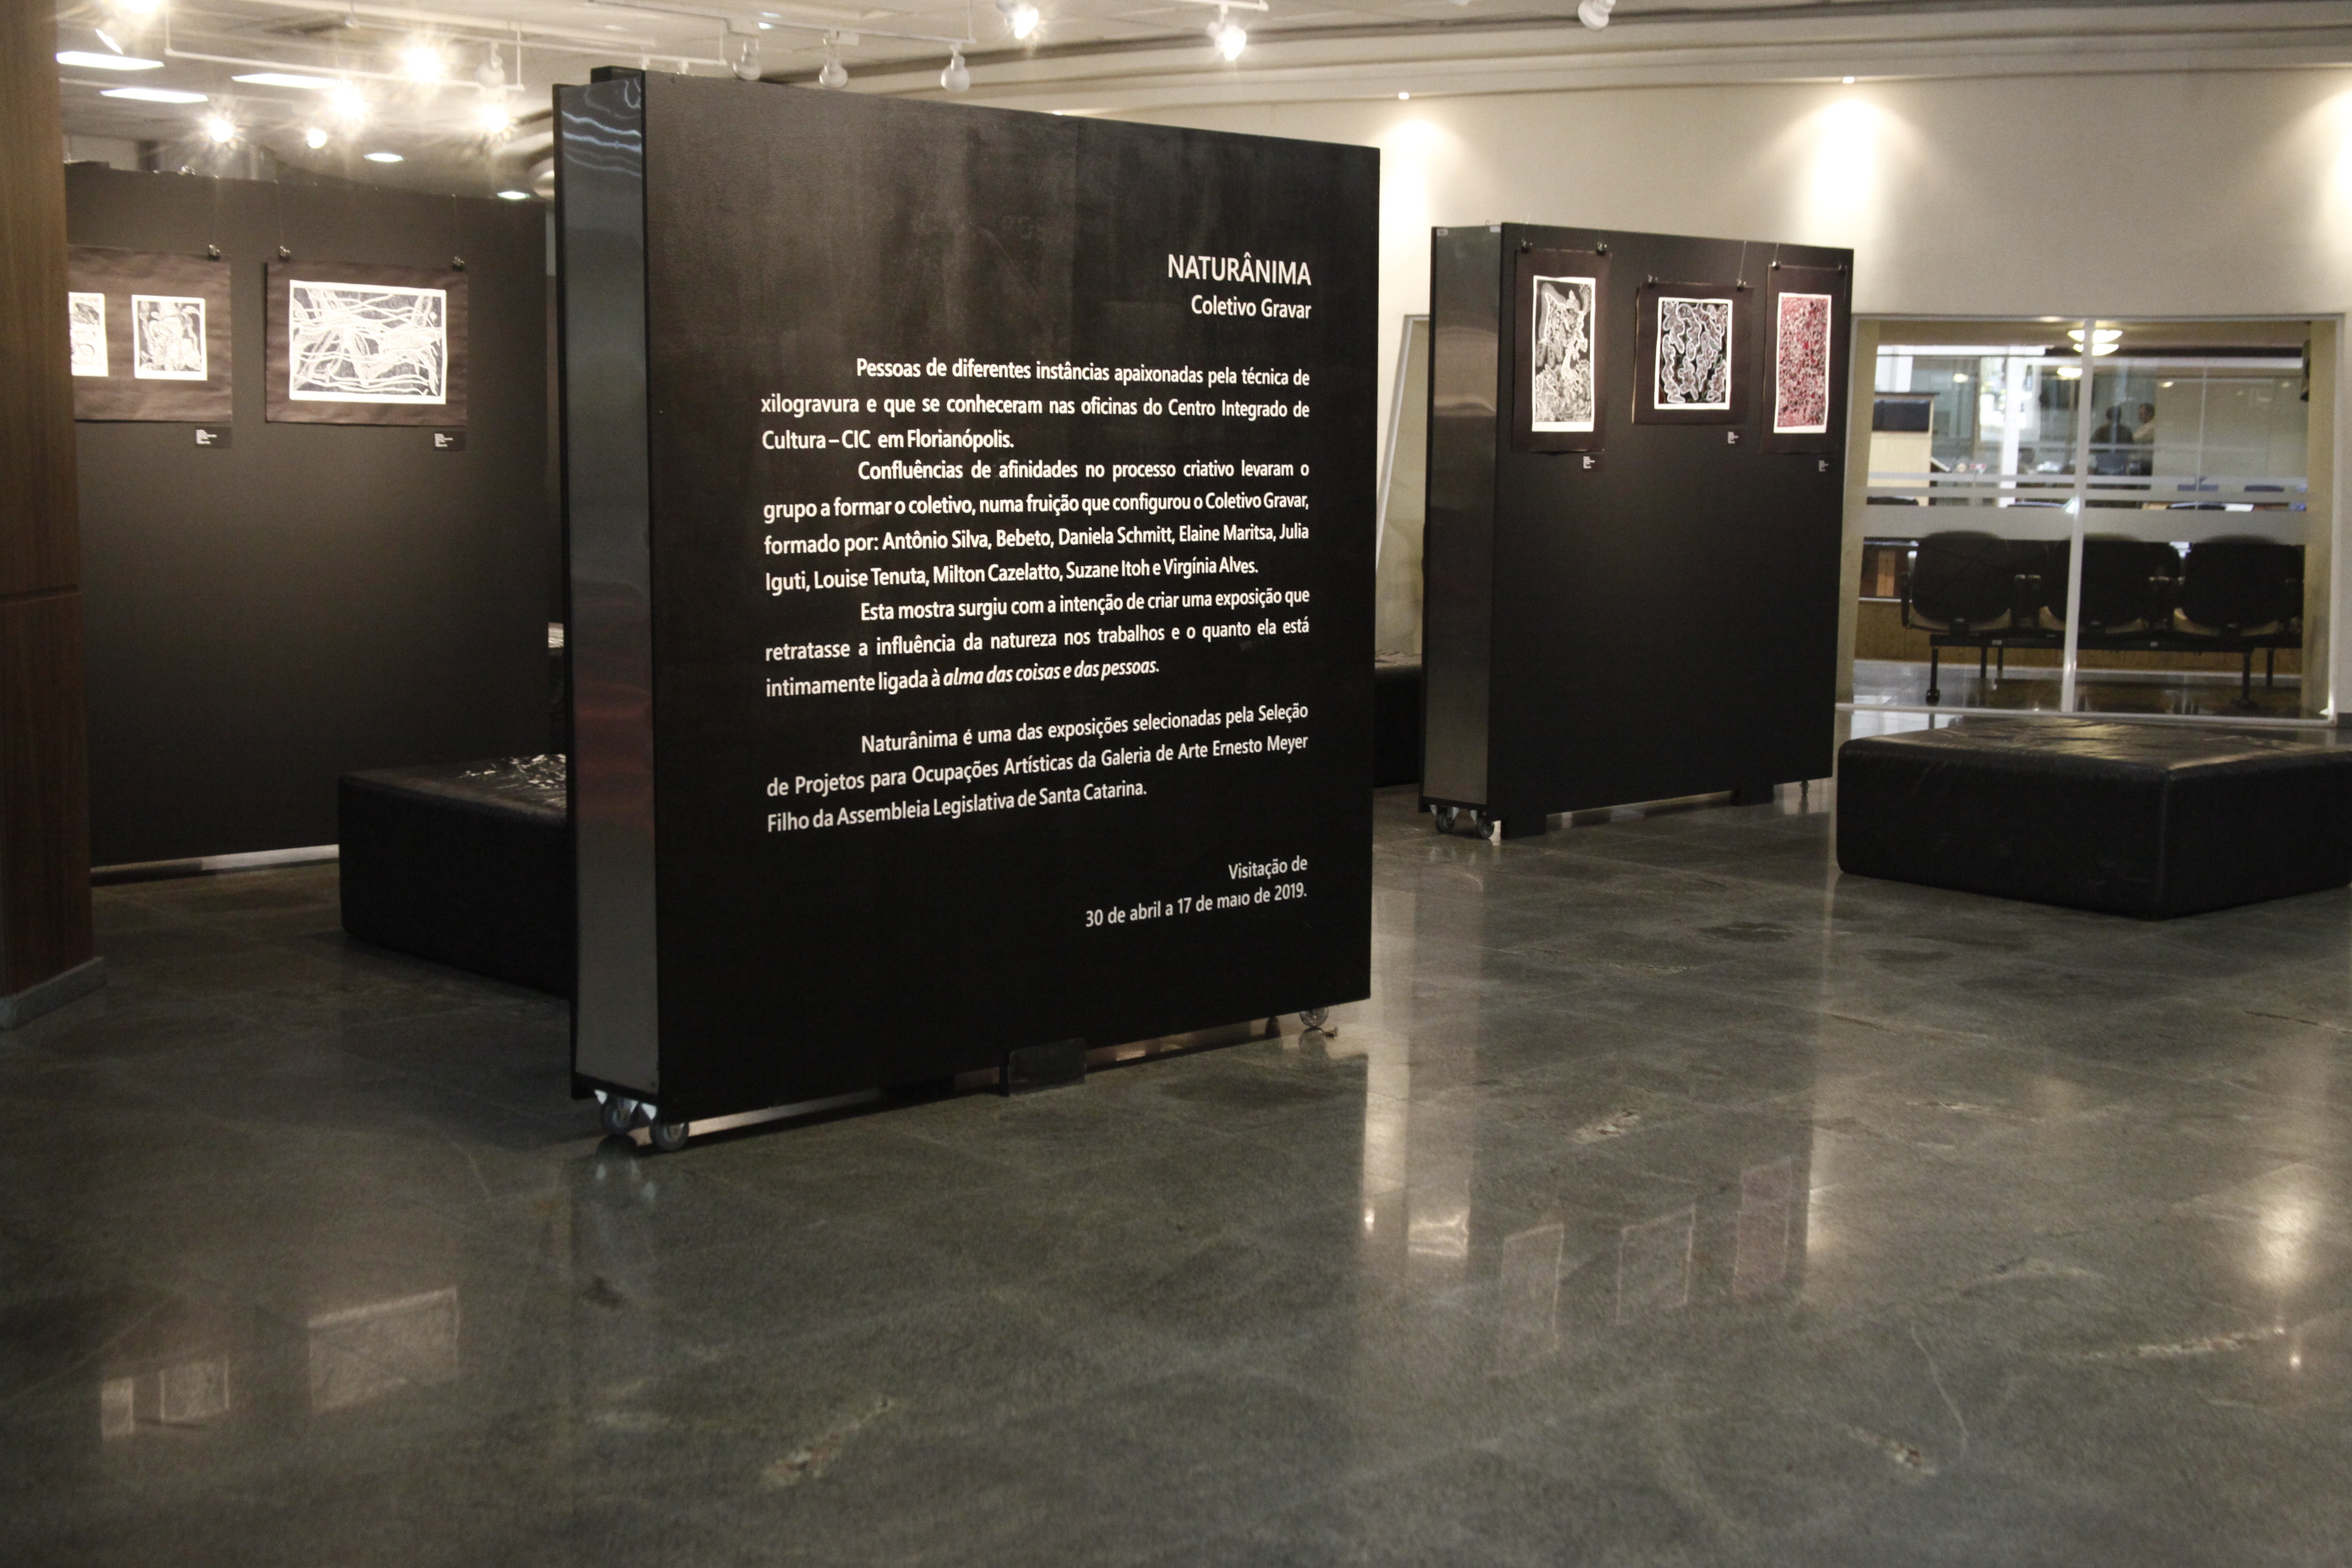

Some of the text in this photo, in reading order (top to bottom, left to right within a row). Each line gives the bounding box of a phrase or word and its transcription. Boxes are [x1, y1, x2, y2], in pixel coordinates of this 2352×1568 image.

[1168, 251, 1311, 286] NATURÂNIMA
[1190, 294, 1311, 318] Coletivo Gravar
[857, 357, 1309, 388] Pessoas de diferentes instâncias apaixonadas pela técnica de
[760, 392, 1309, 421] xilogravura e que se conheceram nas oficinas do Centro Integrado de
[877, 433, 904, 448] em
[906, 427, 1014, 453] Florianópolis.
[858, 459, 1309, 482] Confluências de afinidades no processo criativo levaram o
[763, 491, 1309, 524] grupo a formar o coletivo, numa fruição que configurou o Coletivo Gravar,
[764, 521, 1309, 557] formado por: Antônio Silva, Bebeto, Daniela Schmitt, Elaine Maritsa, Julia
[765, 555, 1258, 596] Iguti, Louise Tenuta, Milton Cazelatto, Suzane Itoh e Virgínia Alves.
[860, 587, 1309, 620] Esta mostra surgiu com a intenção de criar uma exposição que
[765, 615, 1309, 661] retratasse a influência da natureza nos trabalhos e o quanto ela está
[765, 659, 1159, 697] intimamente ligada à alma das coisas e das pessoas.
[861, 702, 1308, 753] Naturânima é uma das exposições selecionadas pela Seleção
[766, 734, 1308, 797] de Projetos para Ocupações Artísticas da Galeria de Arte Ernesto Meyer
[767, 779, 1146, 832] Filho da Assembleia Legislativa de Santa Catarina.
[1228, 854, 1307, 879] Visitação de
[1085, 908, 1103, 927] 30
[1107, 906, 1125, 923] de
[1130, 900, 1161, 921] abril
[1164, 903, 1173, 916] a
[1177, 896, 1191, 913] 17
[1195, 894, 1212, 912] de
[1254, 886, 1271, 903] de
[1274, 881, 1307, 901] 2019.
